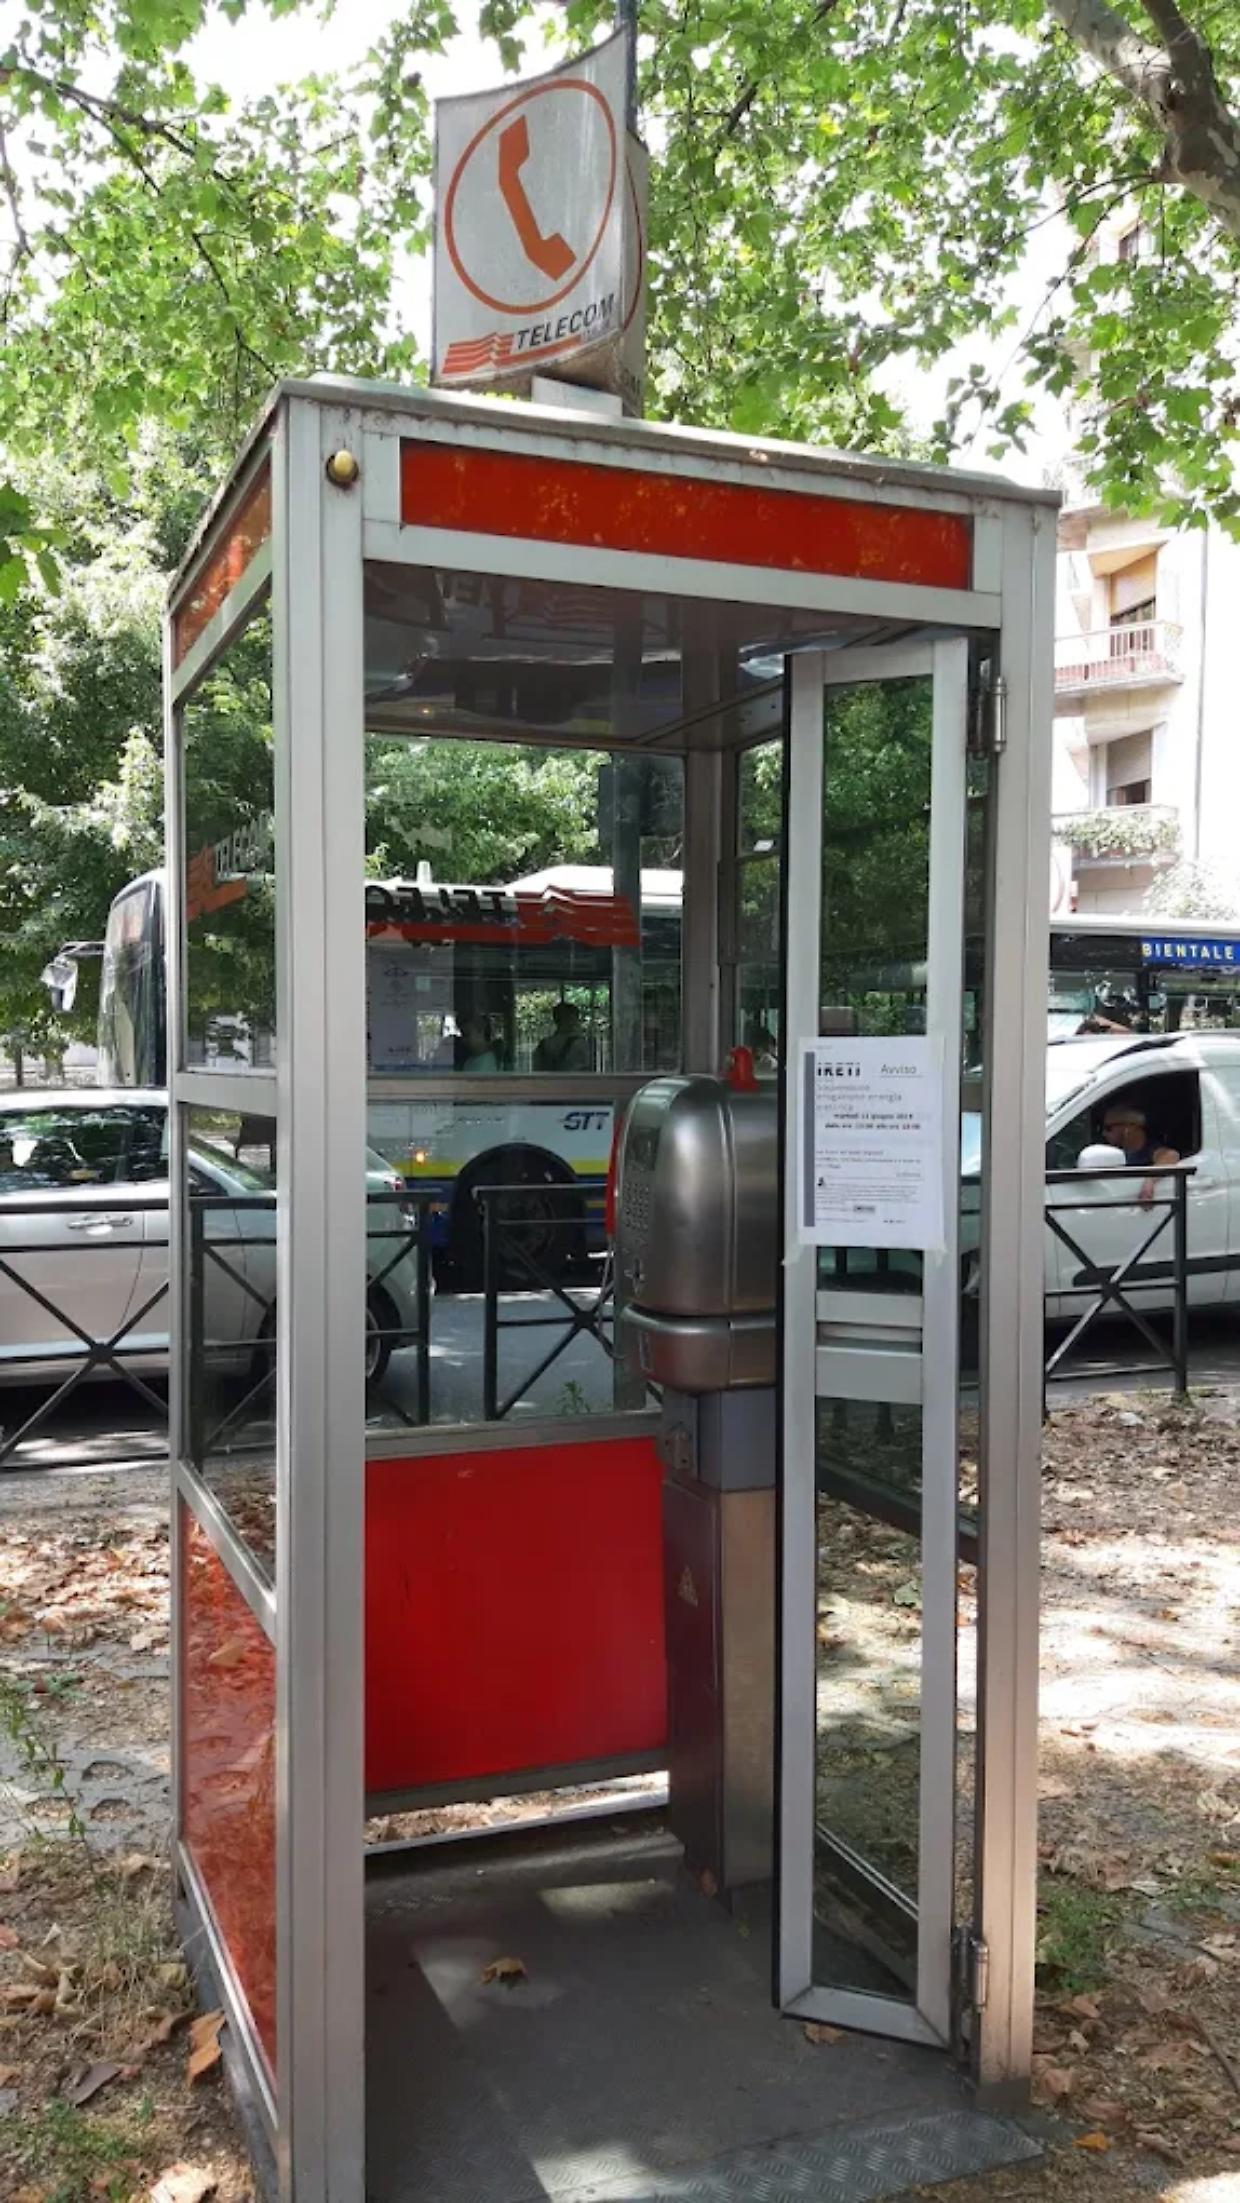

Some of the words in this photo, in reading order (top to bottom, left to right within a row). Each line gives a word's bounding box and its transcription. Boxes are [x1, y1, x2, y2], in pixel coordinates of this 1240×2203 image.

[517, 294, 614, 350] TELECOM
[1142, 942, 1234, 960] BIENTALE
[880, 1064, 917, 1075] Avviso
